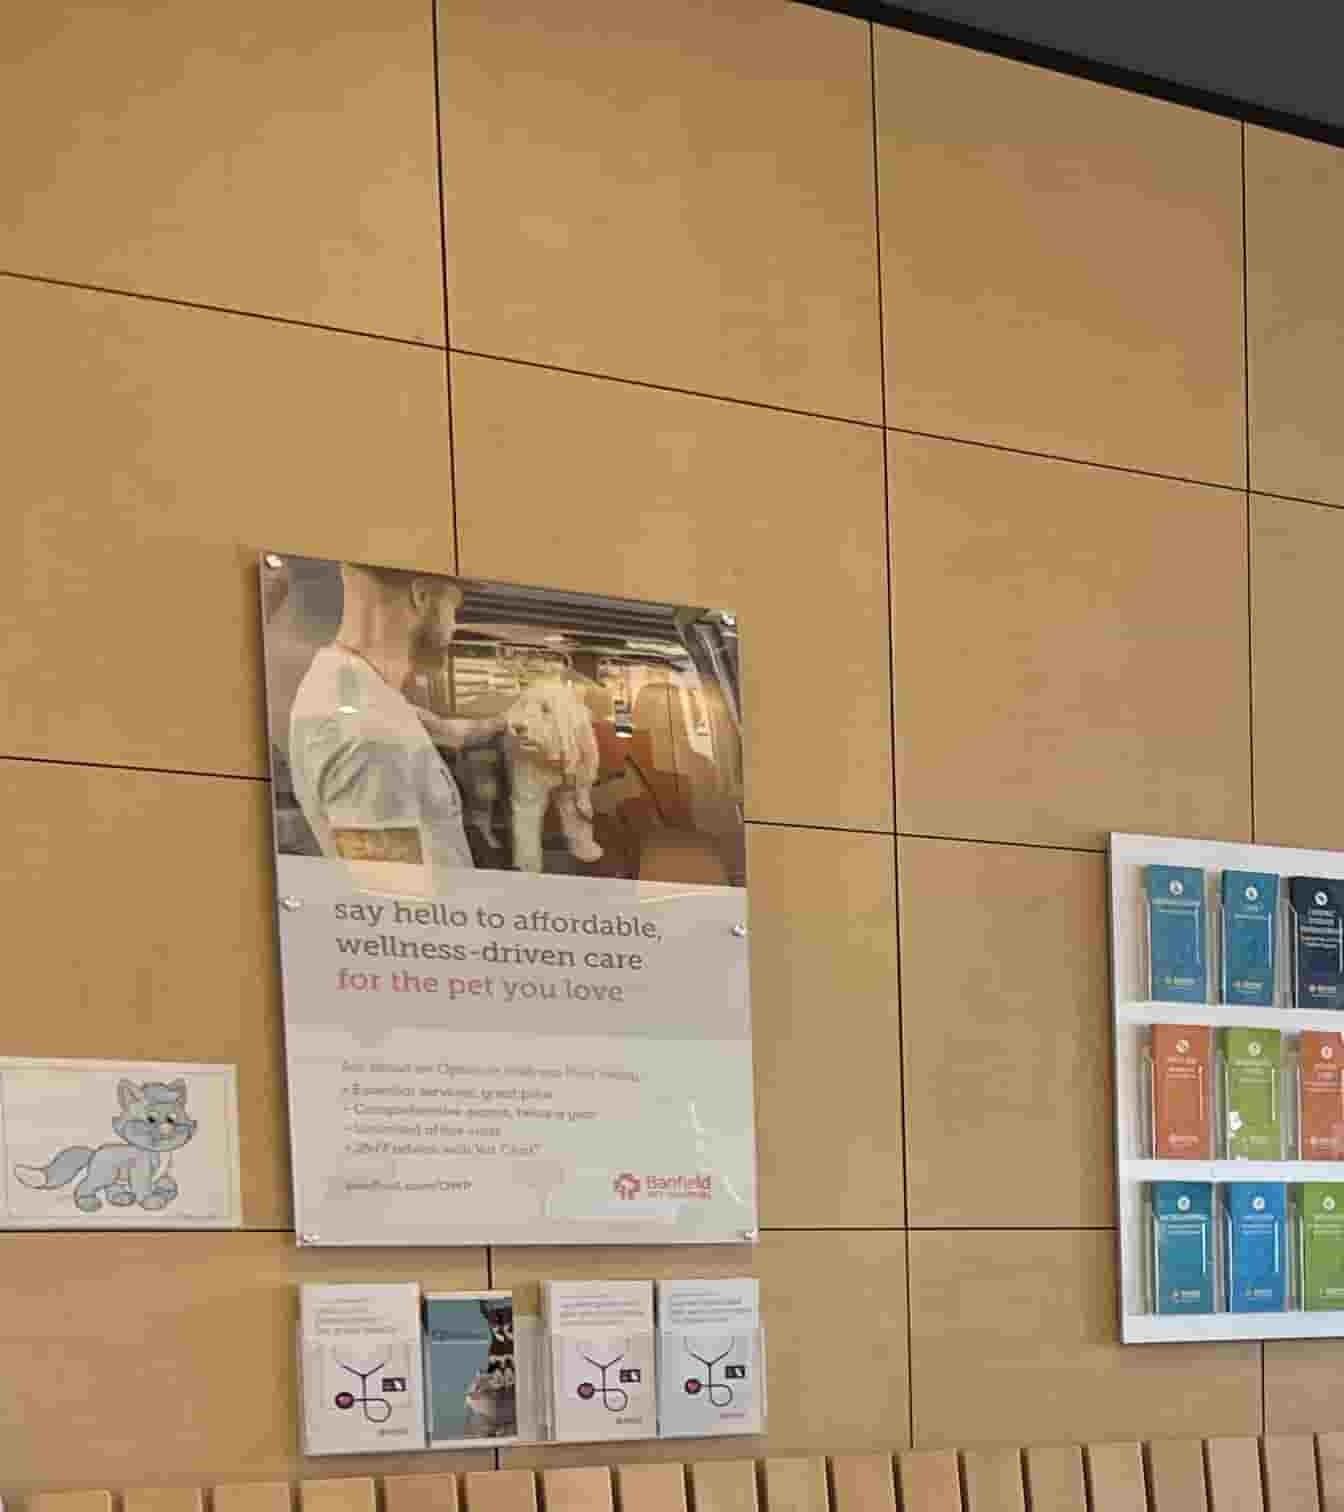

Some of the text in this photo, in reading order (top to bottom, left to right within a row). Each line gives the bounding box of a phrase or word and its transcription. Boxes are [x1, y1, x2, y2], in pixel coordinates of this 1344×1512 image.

[335, 901, 662, 944] say hello to affordable,
[335, 935, 643, 970] wellness-driven care
[336, 968, 625, 1002] for the pet you love
